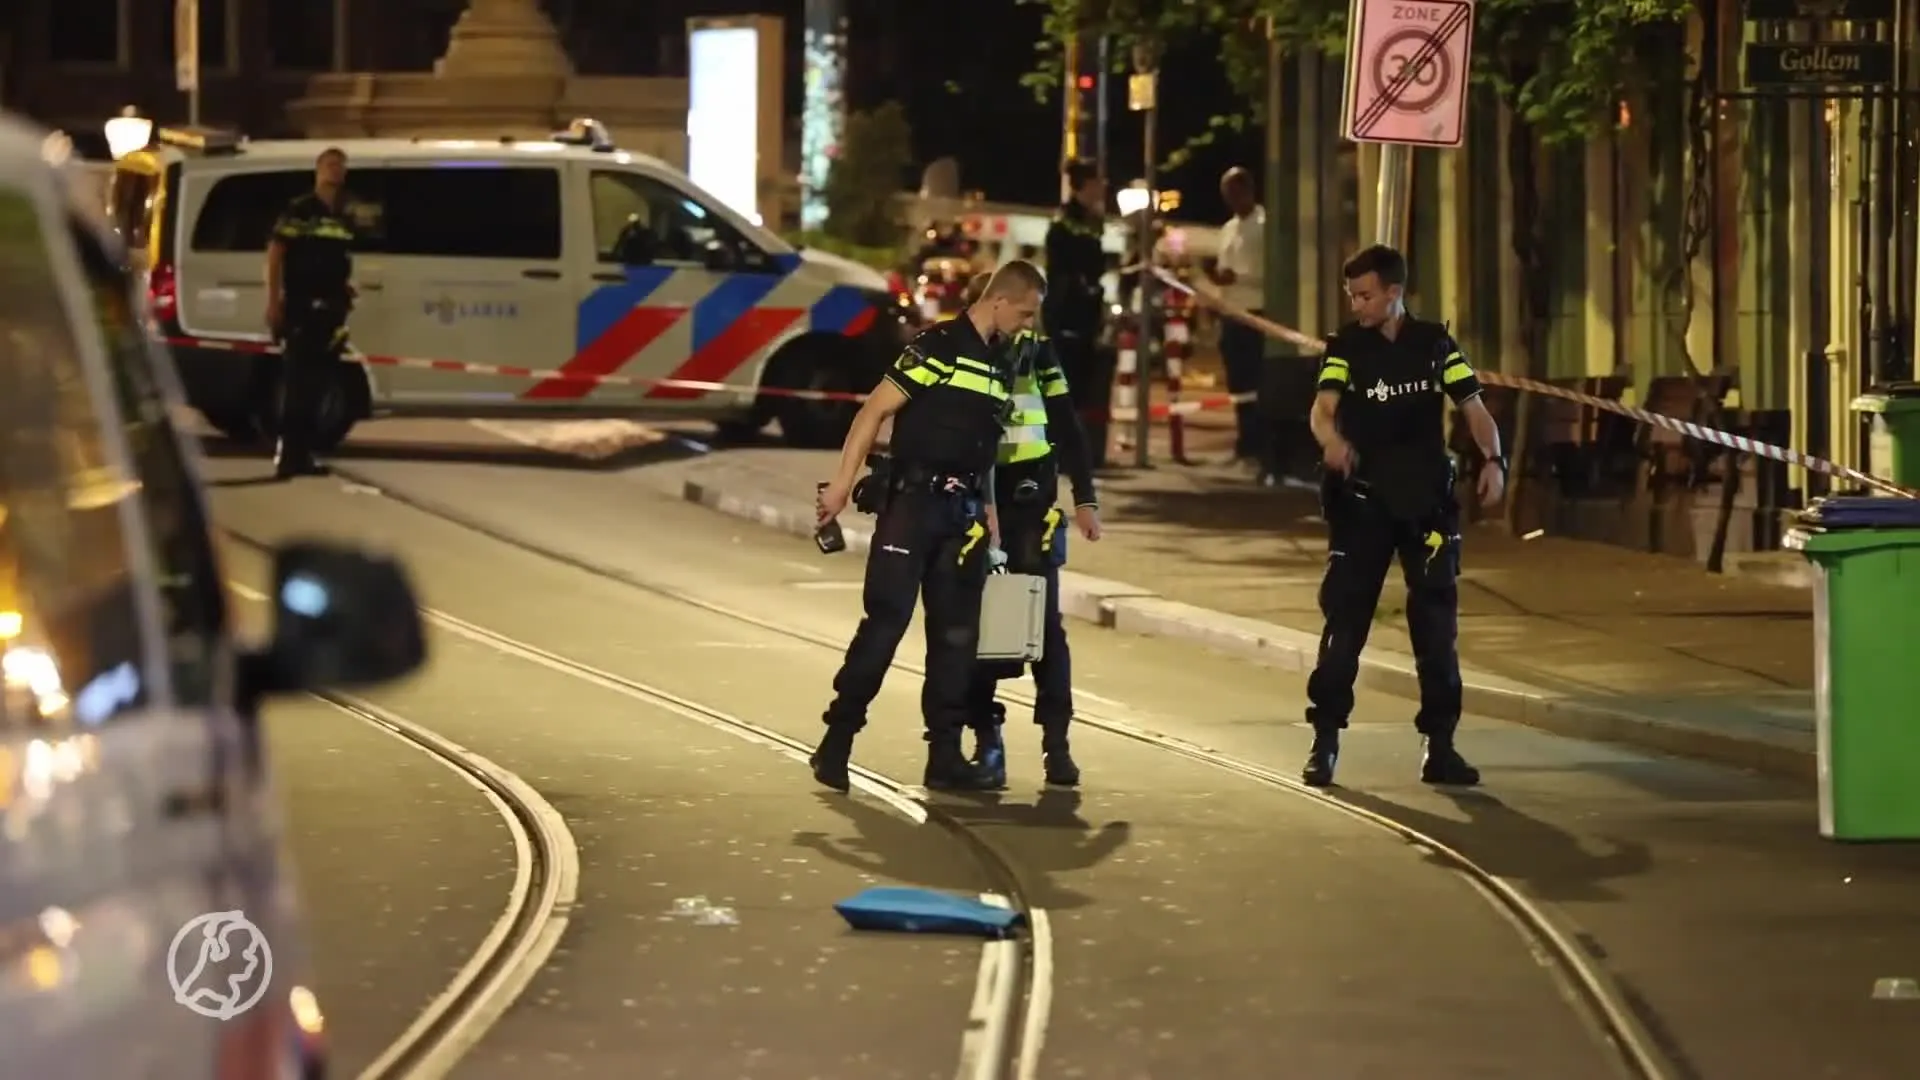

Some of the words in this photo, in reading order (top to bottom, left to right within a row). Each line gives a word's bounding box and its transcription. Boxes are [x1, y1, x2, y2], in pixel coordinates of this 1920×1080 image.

[1392, 6, 1440, 21] ZONE
[1387, 54, 1437, 86] 30
[1779, 46, 1860, 71] Gollem
[1366, 378, 1429, 402] POLITIE
